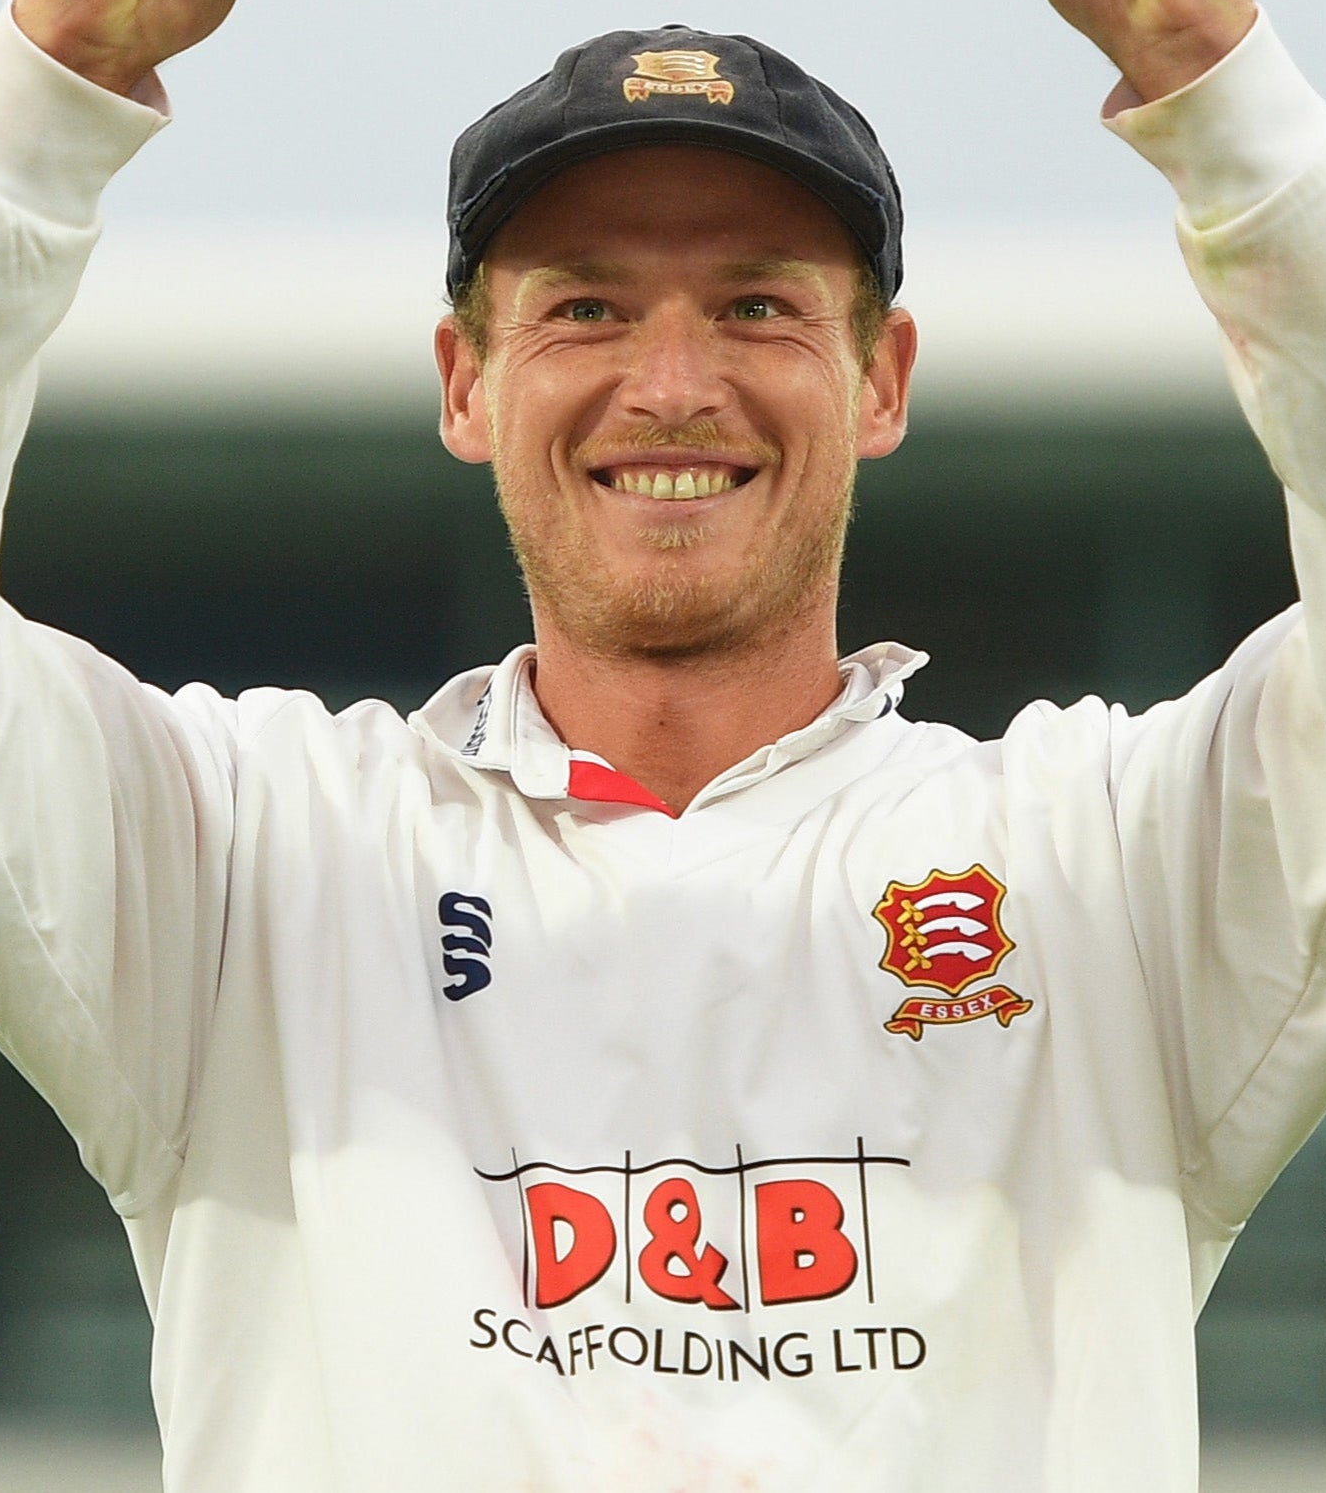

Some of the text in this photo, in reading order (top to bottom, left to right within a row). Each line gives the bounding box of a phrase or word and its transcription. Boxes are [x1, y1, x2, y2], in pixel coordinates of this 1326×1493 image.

[920, 994, 995, 1018] ESSEX
[526, 1177, 858, 1311] D&B
[470, 1308, 927, 1382] SCAFFOLDING LTD
